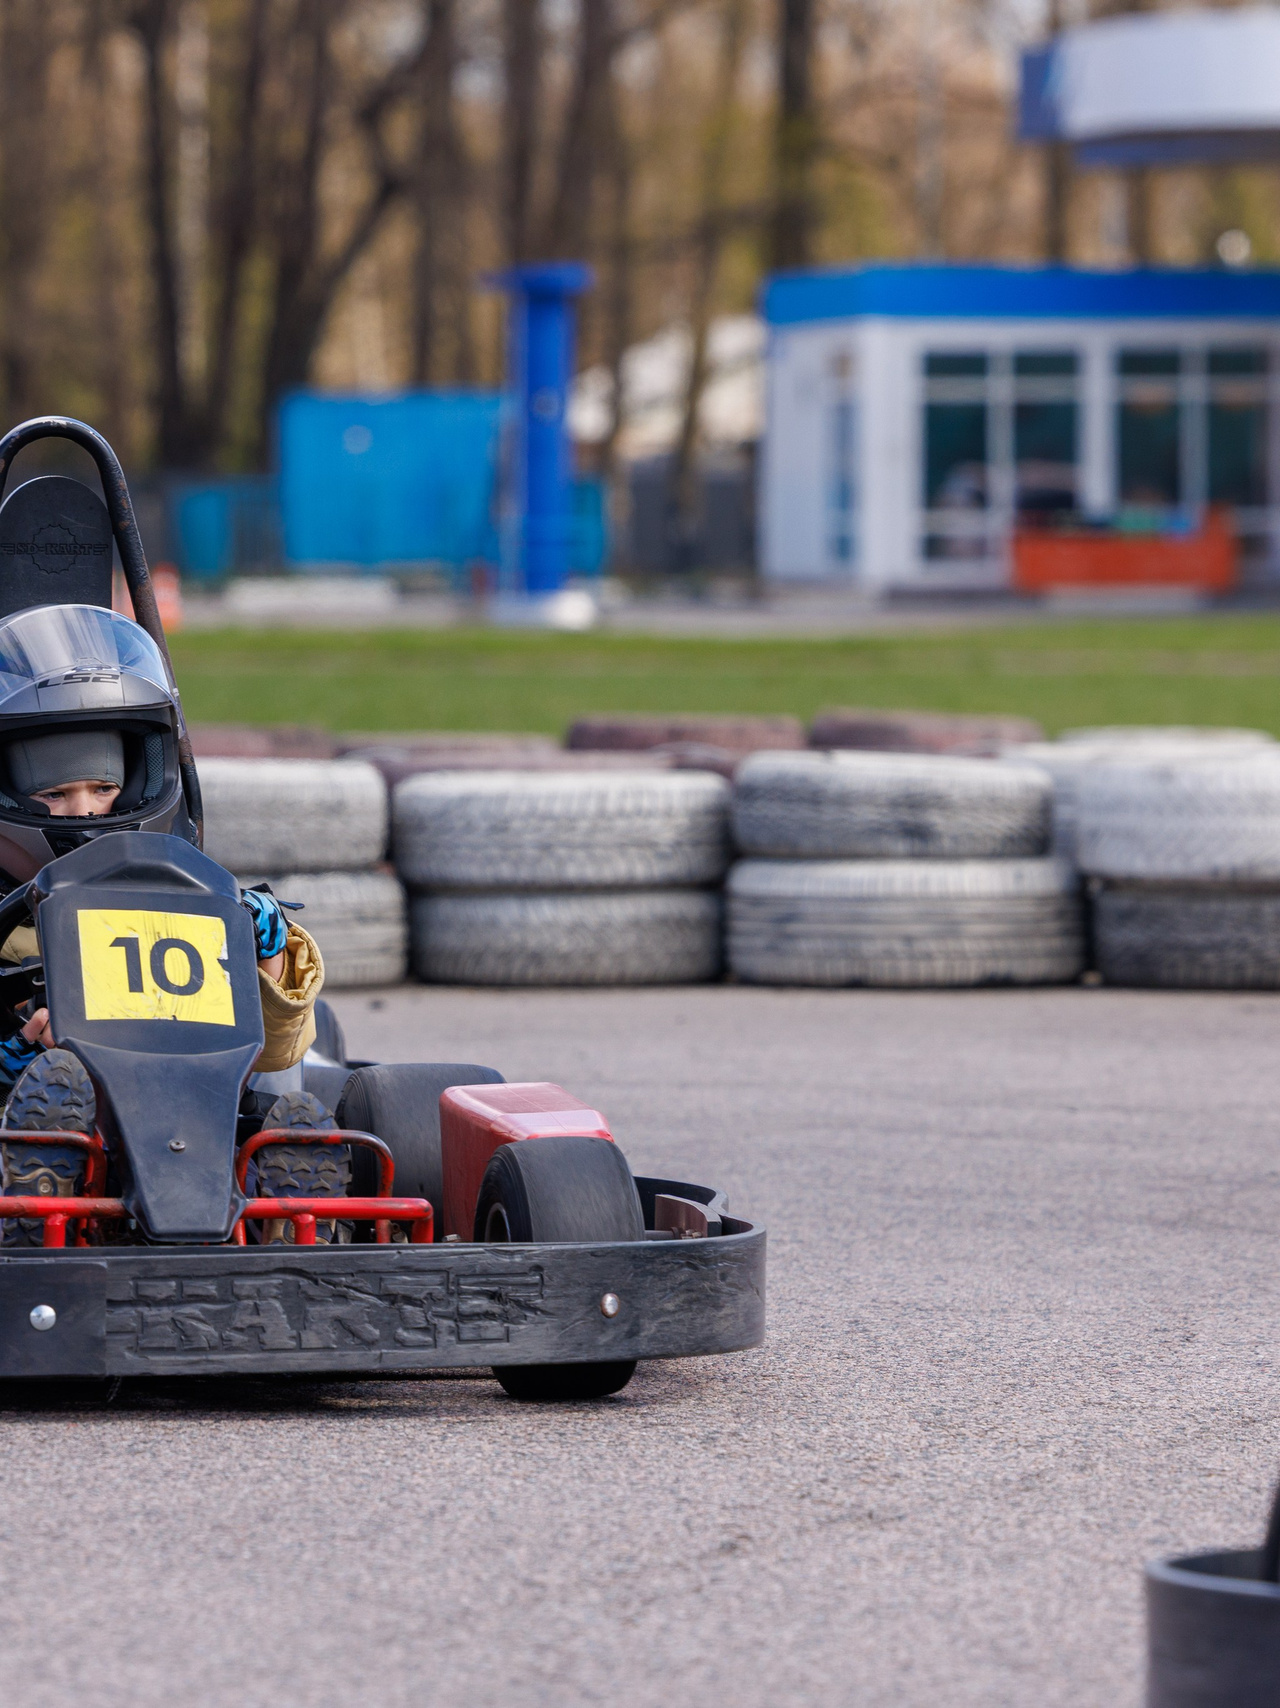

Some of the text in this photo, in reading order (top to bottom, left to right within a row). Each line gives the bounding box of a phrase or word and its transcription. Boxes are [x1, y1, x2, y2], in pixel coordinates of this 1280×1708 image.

[16, 542, 92, 556] SD-KART
[37, 672, 120, 689] LS2
[109, 937, 205, 996] 10
